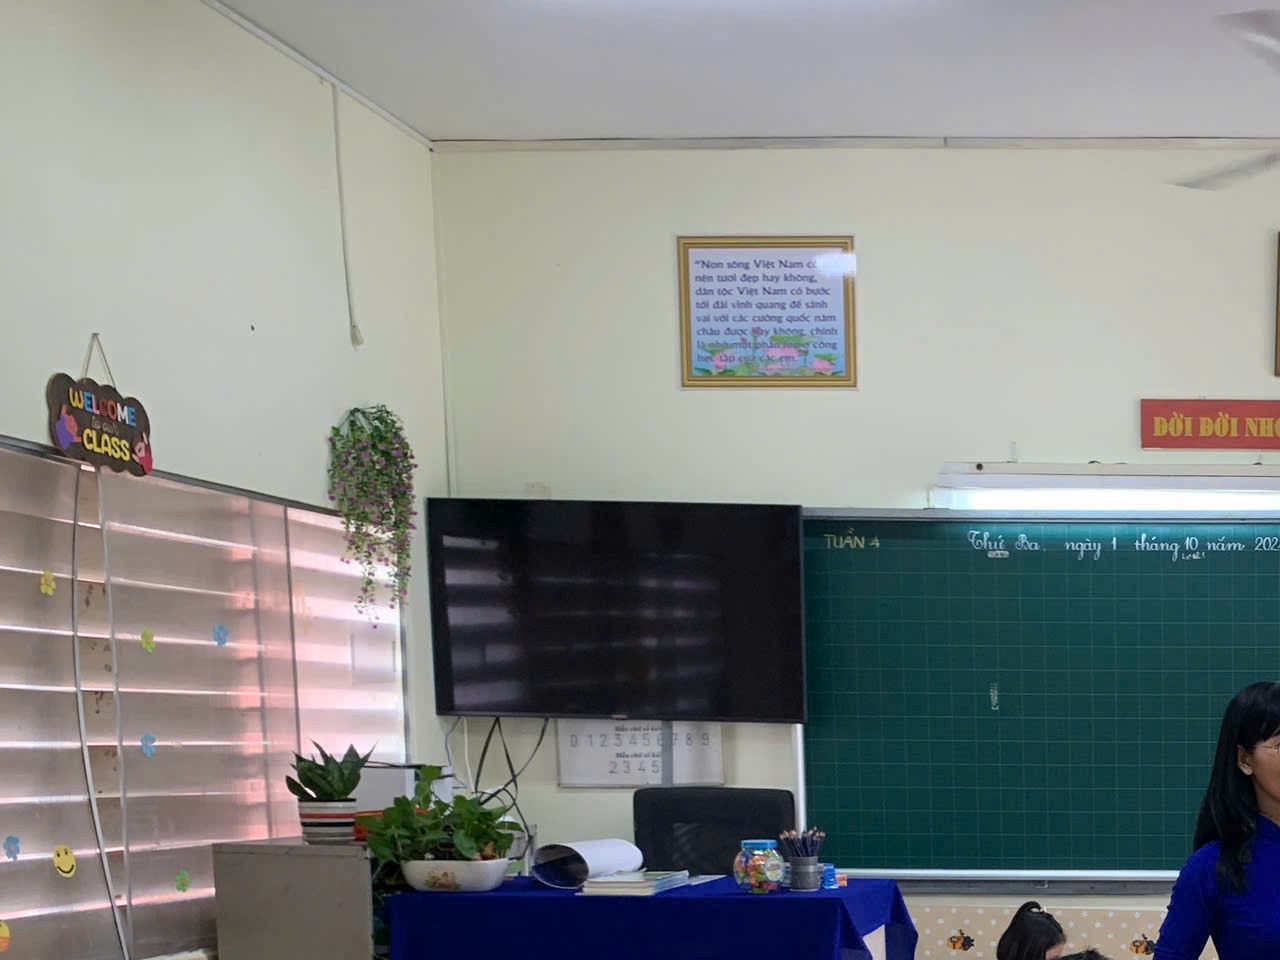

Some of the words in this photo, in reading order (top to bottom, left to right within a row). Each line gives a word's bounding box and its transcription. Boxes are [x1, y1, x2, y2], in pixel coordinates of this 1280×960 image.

[753, 260, 775, 269] Việt
[779, 260, 803, 269] Nam
[740, 272, 759, 284] đẹp
[762, 272, 780, 283] hay
[717, 286, 733, 297] tộc
[737, 286, 758, 297] Việt
[762, 286, 787, 296] Nam
[790, 286, 803, 296] có
[805, 286, 831, 296] bước
[755, 302, 787, 311] quang
[695, 314, 711, 322] vai
[786, 314, 811, 324] quốc
[69, 387, 137, 427] WELCOME
[1152, 412, 1193, 437] ĐỜI
[1199, 412, 1239, 437] ĐỜI
[83, 428, 130, 461] CLASS
[824, 527, 865, 549] TUẦN
[869, 536, 880, 549] 4
[967, 530, 1006, 550] Thứ
[1064, 536, 1101, 561] ngày
[1111, 536, 1117, 550] 1
[1134, 533, 1180, 562] tháng
[1184, 536, 1199, 550] 10
[1206, 536, 1245, 550] năm
